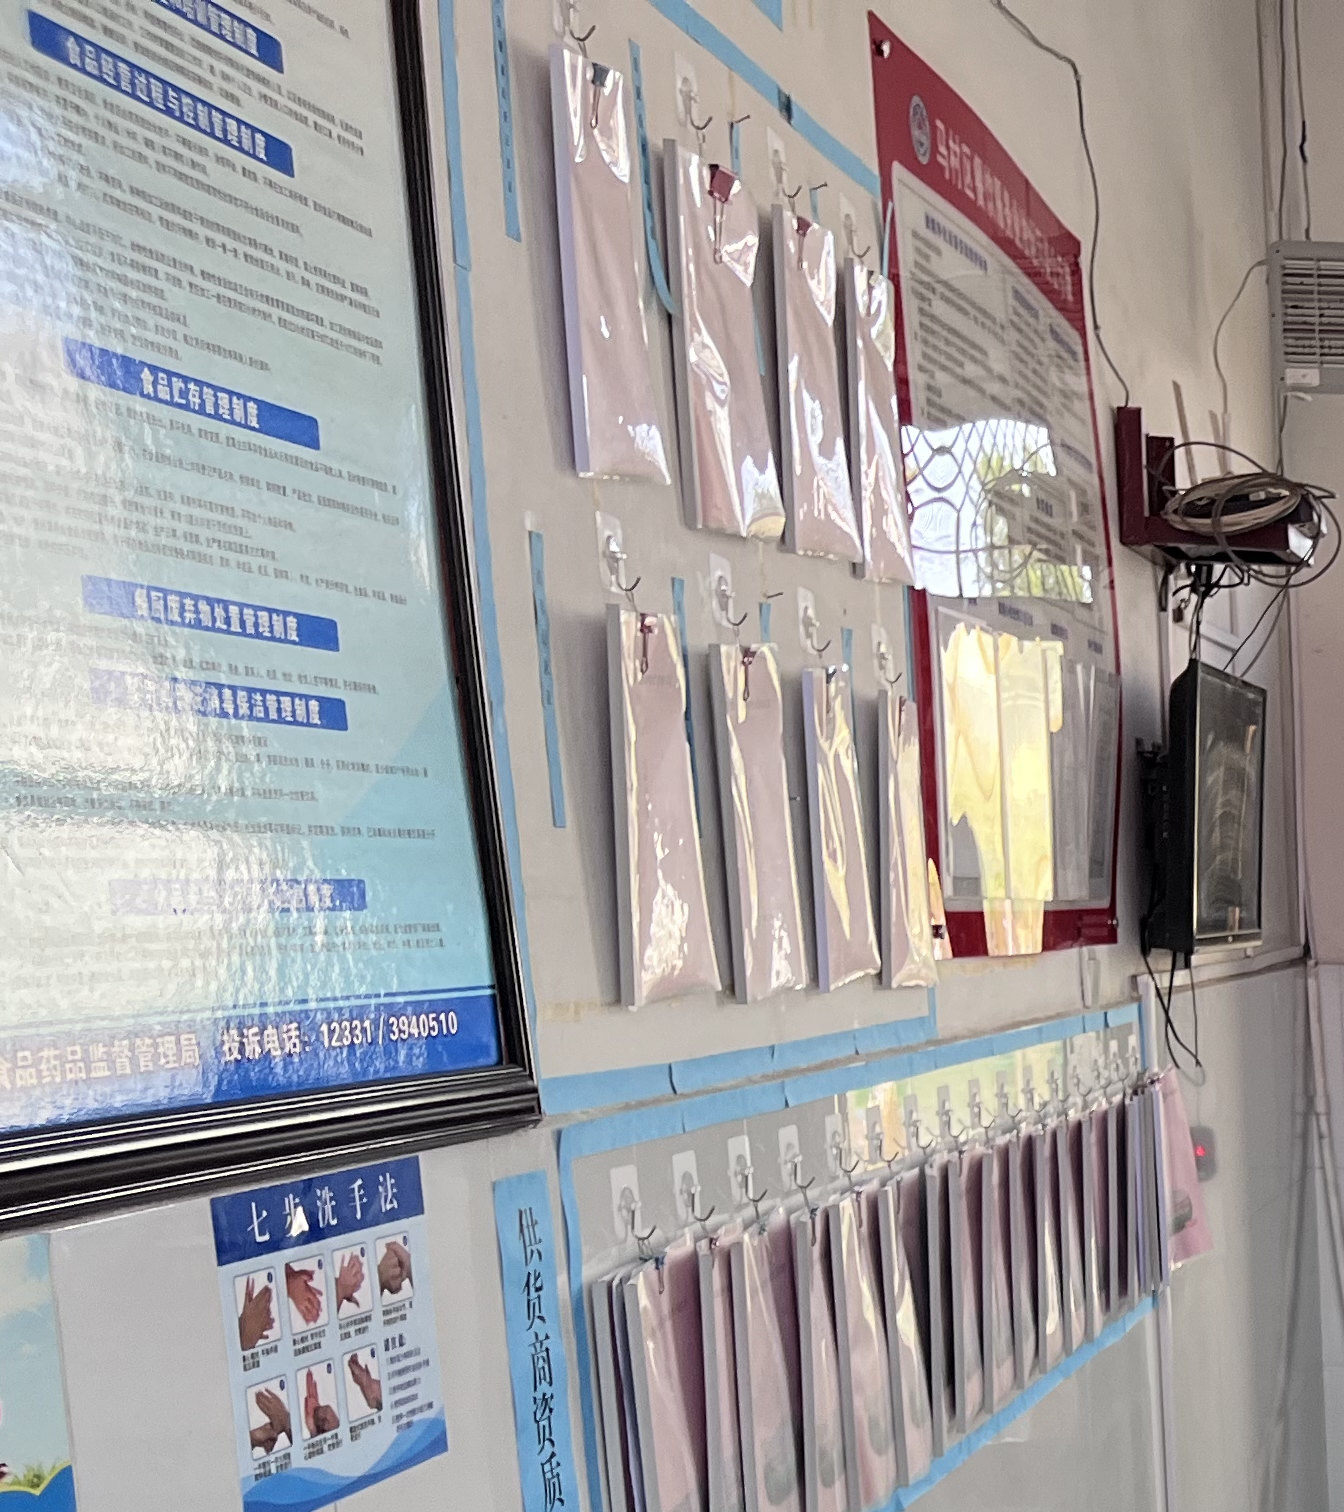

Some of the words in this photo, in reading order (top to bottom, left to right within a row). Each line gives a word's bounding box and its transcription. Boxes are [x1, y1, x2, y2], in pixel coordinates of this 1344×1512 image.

[140, 367, 260, 429] 食品贮存管理制度
